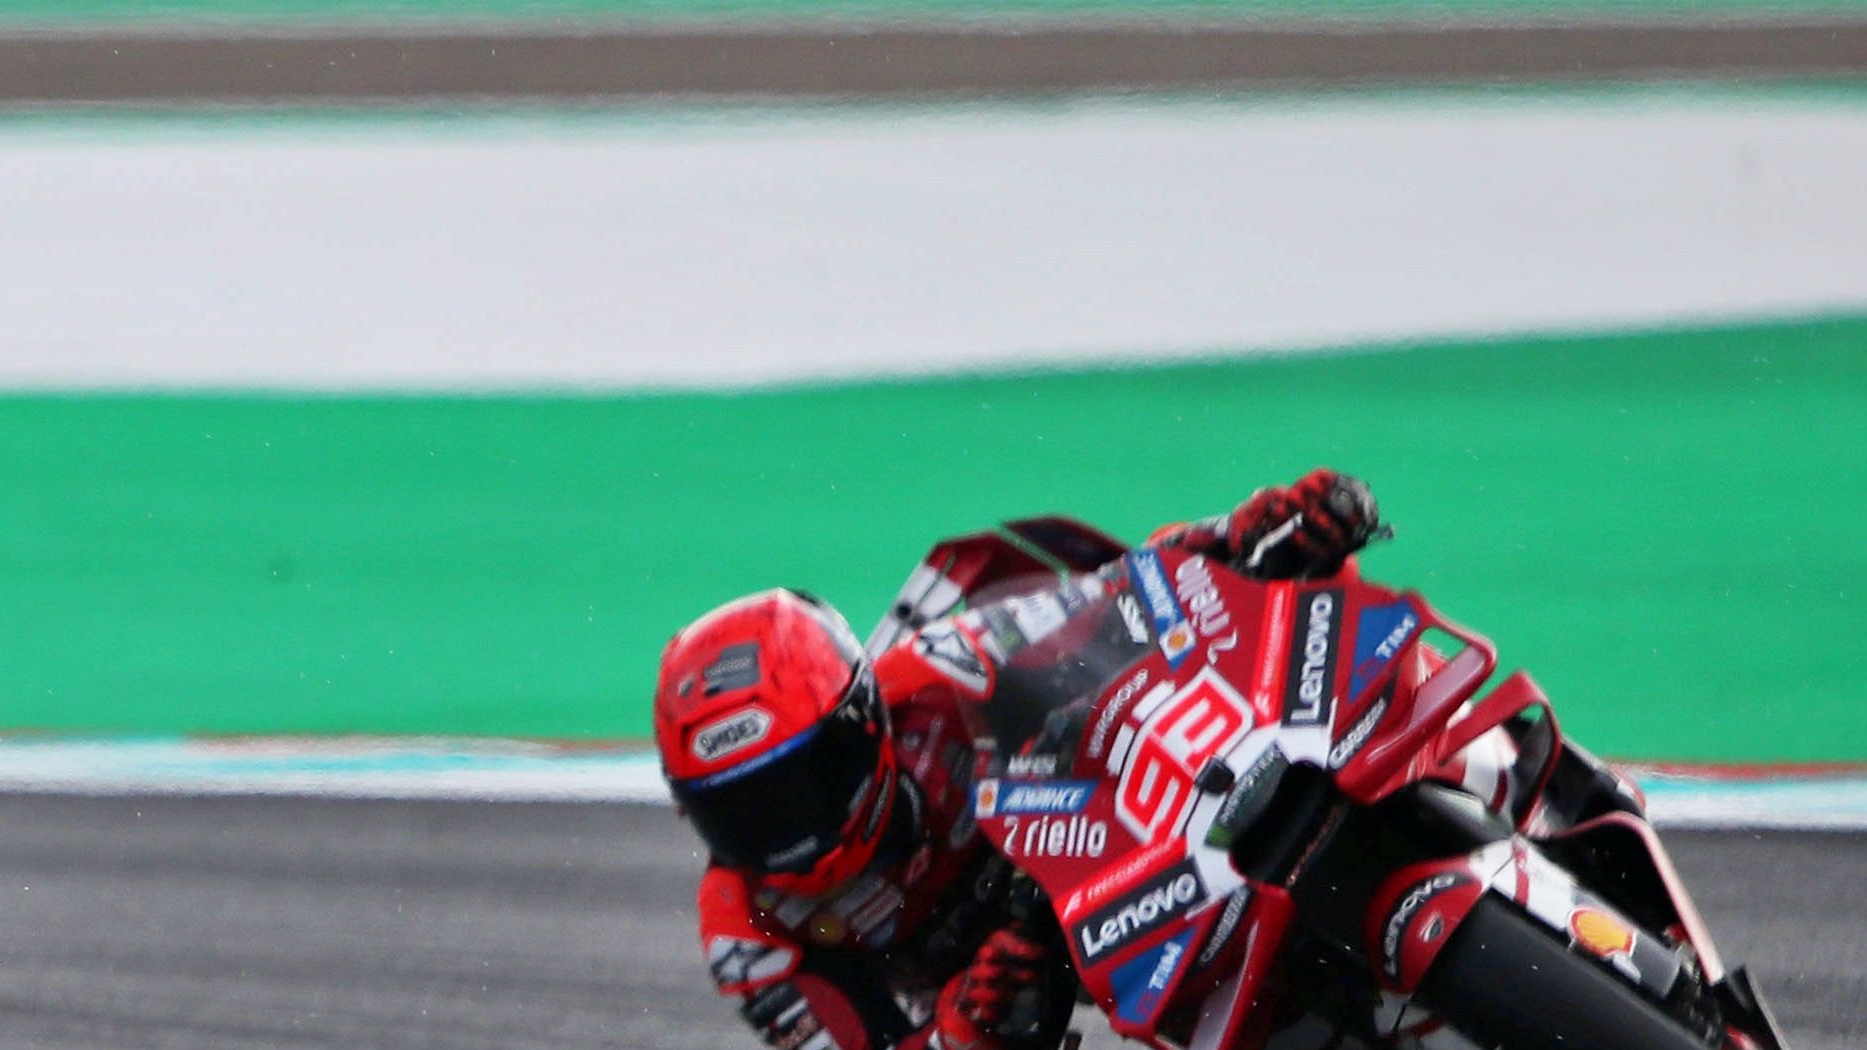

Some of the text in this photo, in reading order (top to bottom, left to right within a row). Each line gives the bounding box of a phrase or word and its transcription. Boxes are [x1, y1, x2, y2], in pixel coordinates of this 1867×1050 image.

[1291, 591, 1333, 722] Lenovo
[1376, 613, 1416, 660] TIM
[1120, 671, 1252, 841] 93
[1024, 815, 1107, 858] riello
[1080, 873, 1199, 960] Lenovo
[1148, 941, 1185, 992] TIM
